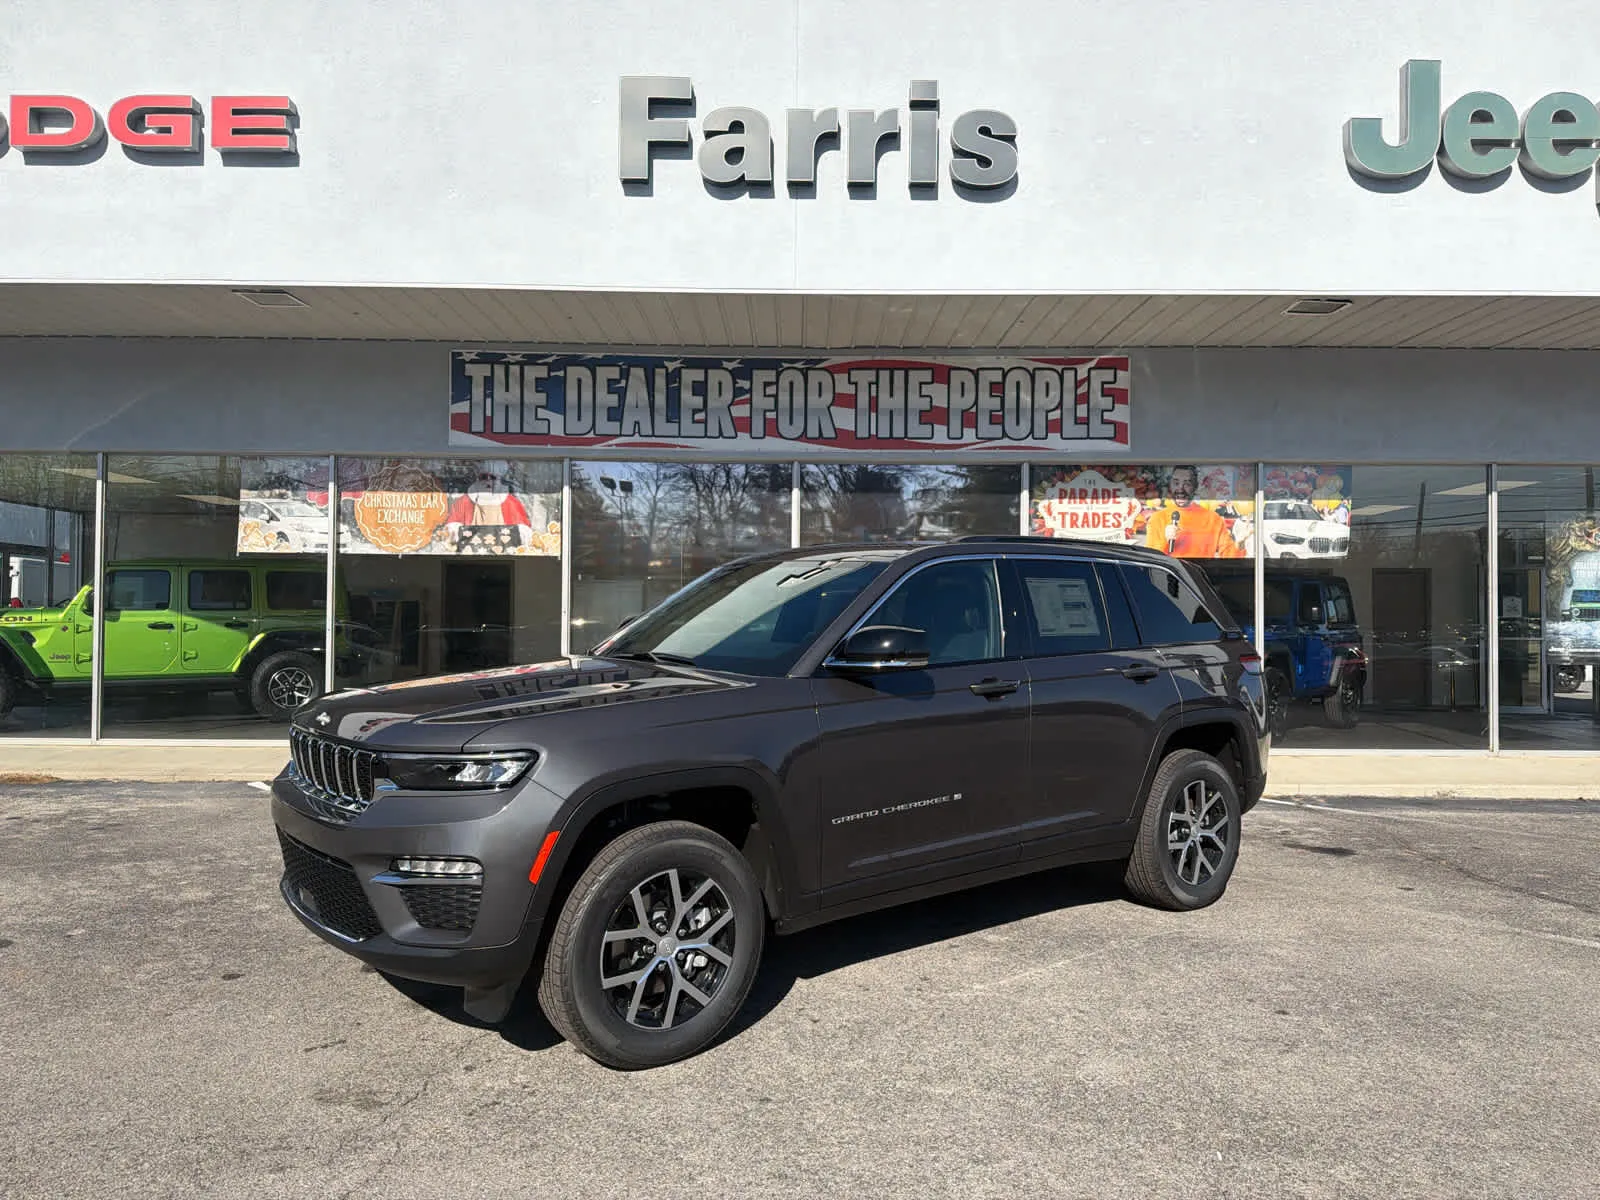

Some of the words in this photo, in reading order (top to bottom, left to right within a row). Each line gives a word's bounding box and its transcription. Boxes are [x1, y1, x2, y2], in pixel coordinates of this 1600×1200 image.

[0, 95, 298, 152] DGE
[619, 75, 1018, 190] Farris
[1344, 59, 1600, 195] Jee
[464, 362, 550, 435] THE
[563, 364, 739, 439] DEALER
[749, 367, 838, 440] FOR
[848, 367, 934, 440] THE
[947, 367, 1118, 440] PEOPLE
[364, 493, 417, 508] CHRISTMAS
[420, 493, 439, 508] CAR
[1058, 487, 1122, 504] PARADE
[378, 508, 425, 524] EXCHANGE
[1058, 512, 1122, 528] TRADES
[49, 652, 71, 661] Jeep
[831, 809, 879, 824] GRAND
[882, 796, 951, 814] CHEROKEE
